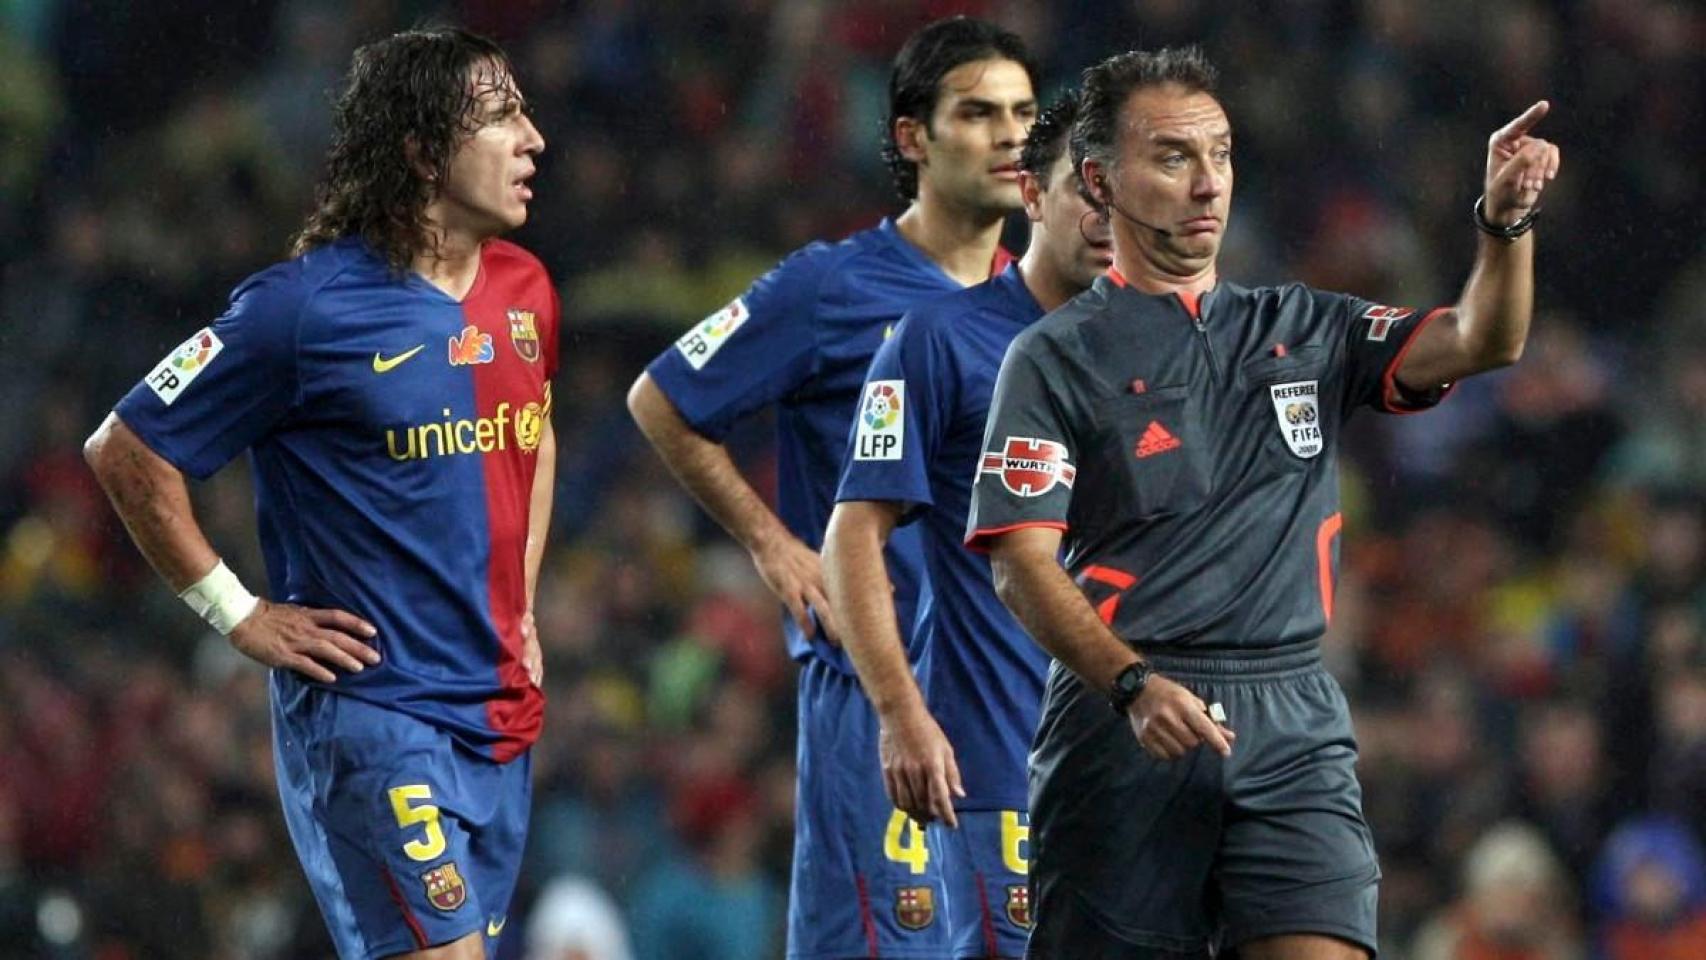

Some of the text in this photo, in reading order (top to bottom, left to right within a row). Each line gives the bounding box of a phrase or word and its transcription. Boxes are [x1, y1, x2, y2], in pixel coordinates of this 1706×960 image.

[681, 333, 708, 356] FP
[149, 367, 179, 391] FP
[1273, 384, 1316, 399] REFEREE
[386, 403, 509, 461] unicef
[1292, 427, 1320, 442] FIFA
[861, 434, 897, 457] LFP
[388, 785, 446, 861] 5
[884, 808, 929, 874] 4
